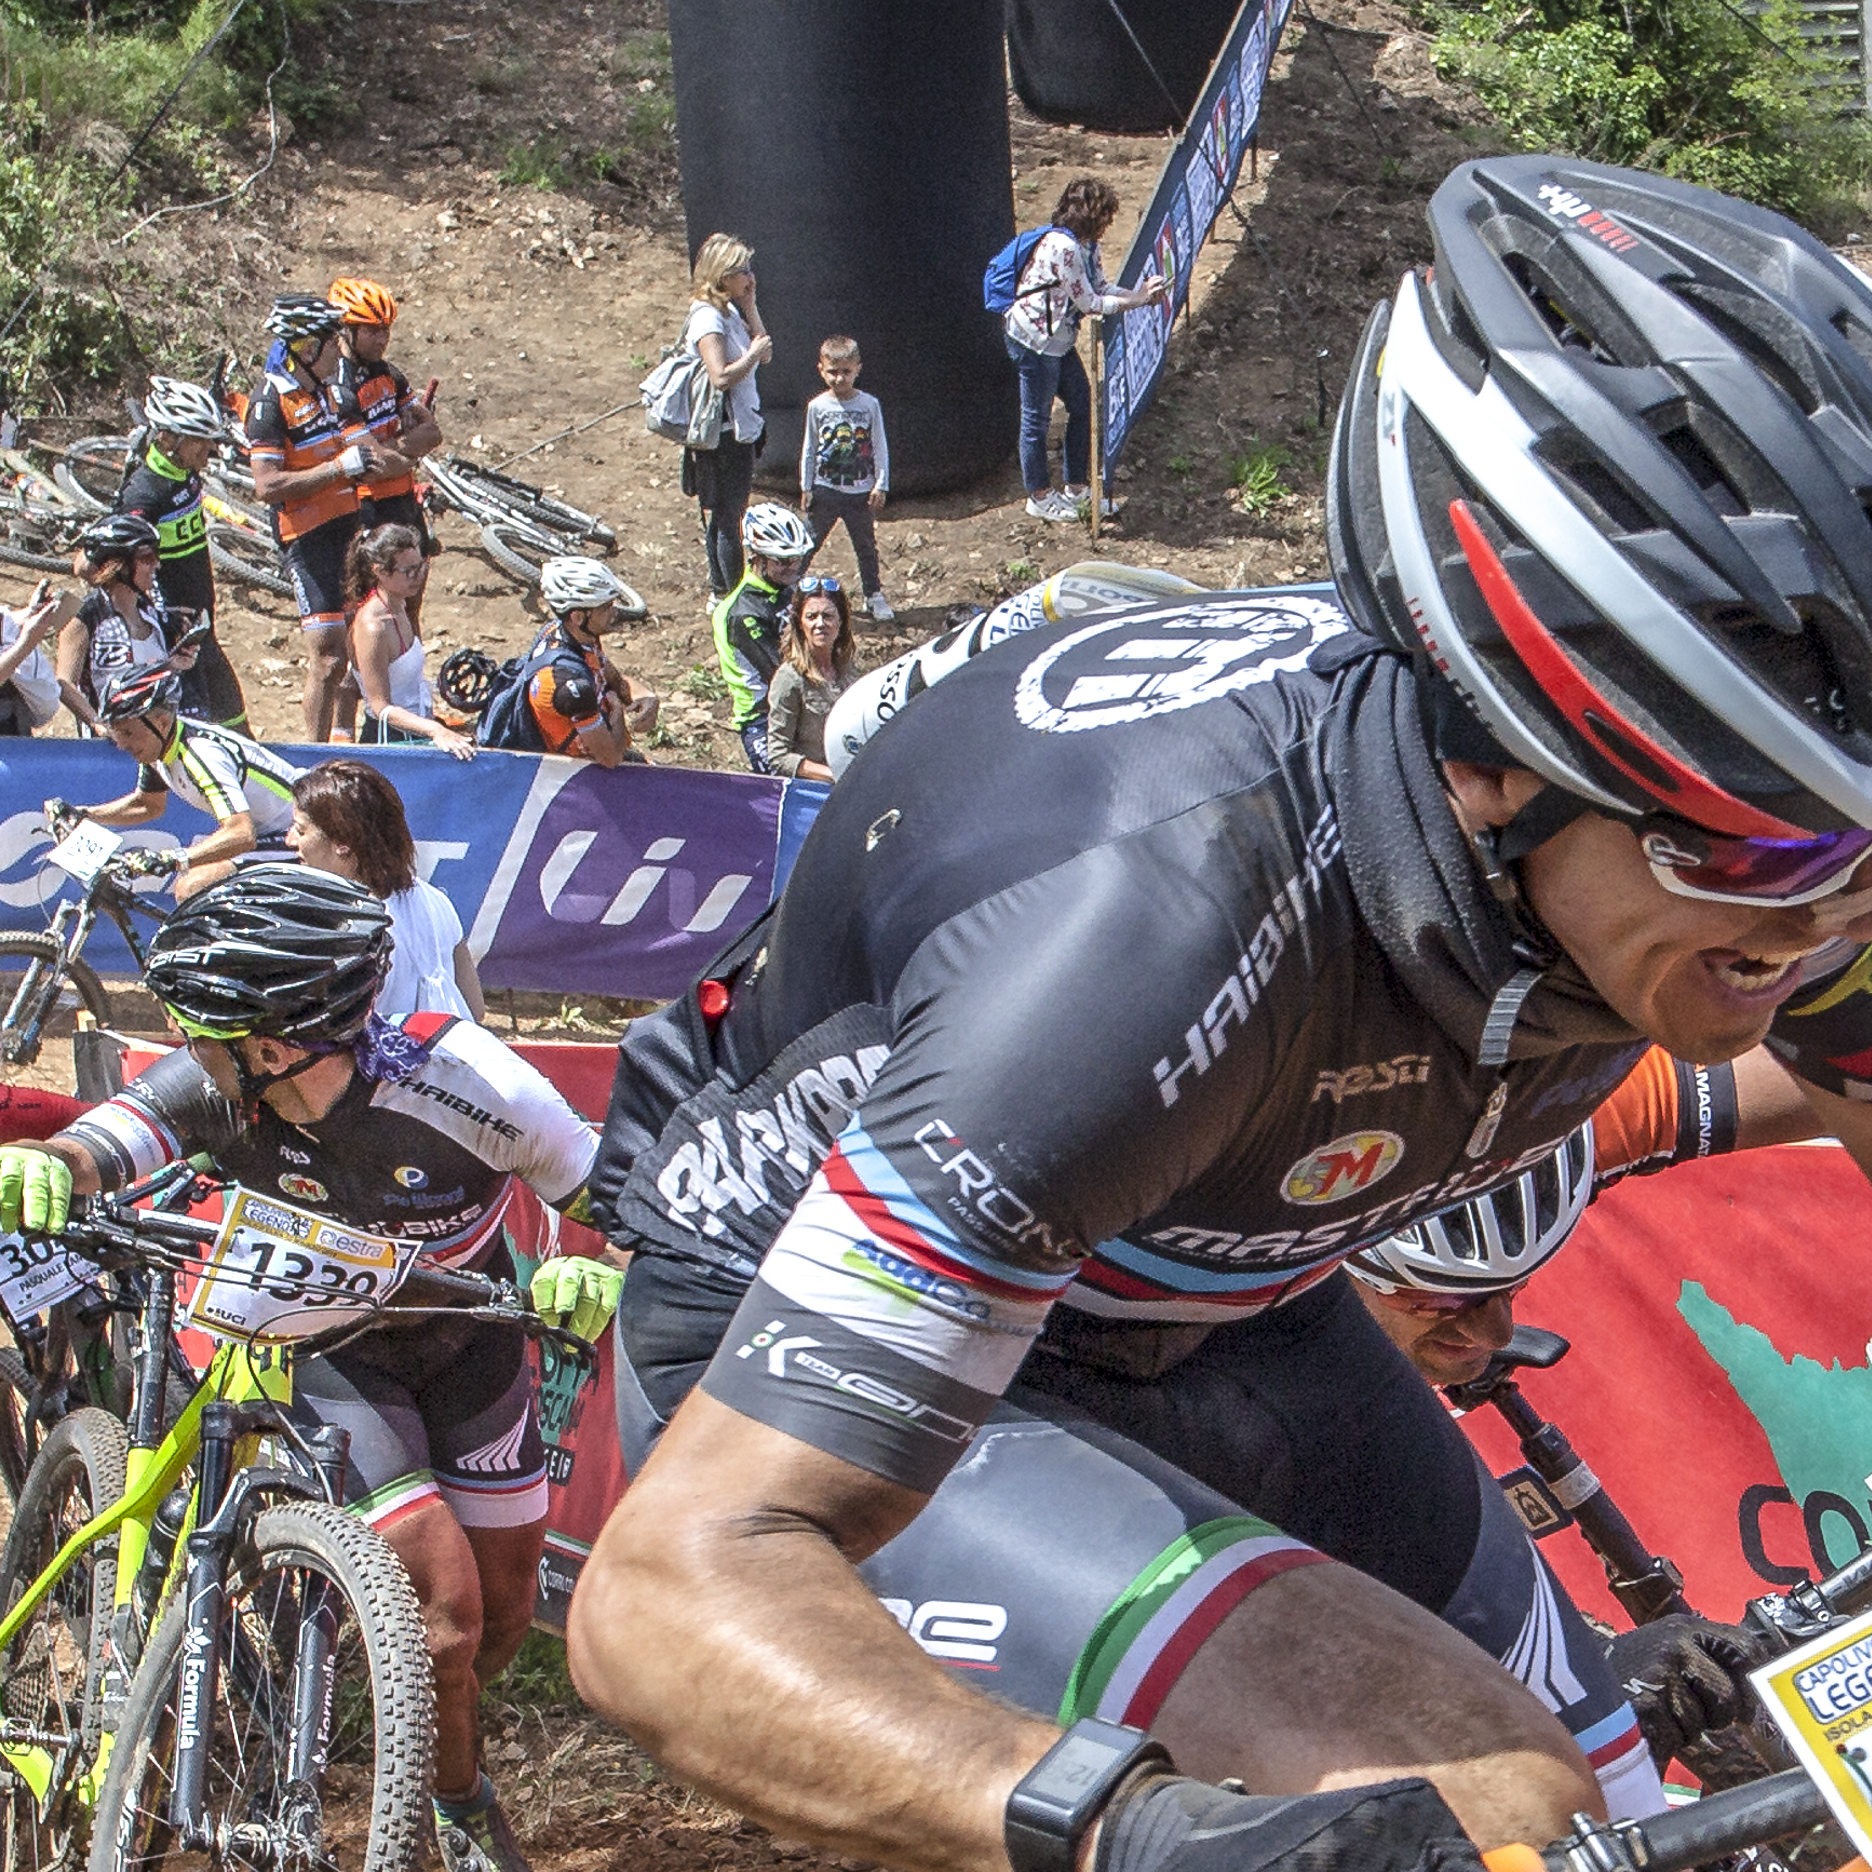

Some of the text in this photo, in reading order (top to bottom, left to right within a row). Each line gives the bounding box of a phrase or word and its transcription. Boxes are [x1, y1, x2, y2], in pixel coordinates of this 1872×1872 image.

[539, 828, 754, 934] Liv
[1151, 803, 1343, 1109] HAIBIKE
[398, 1076, 525, 1142] HAIBIKE
[18, 1262, 66, 1292] PASQUALE
[335, 1234, 383, 1258] estra
[180, 1658, 207, 1750] Formula
